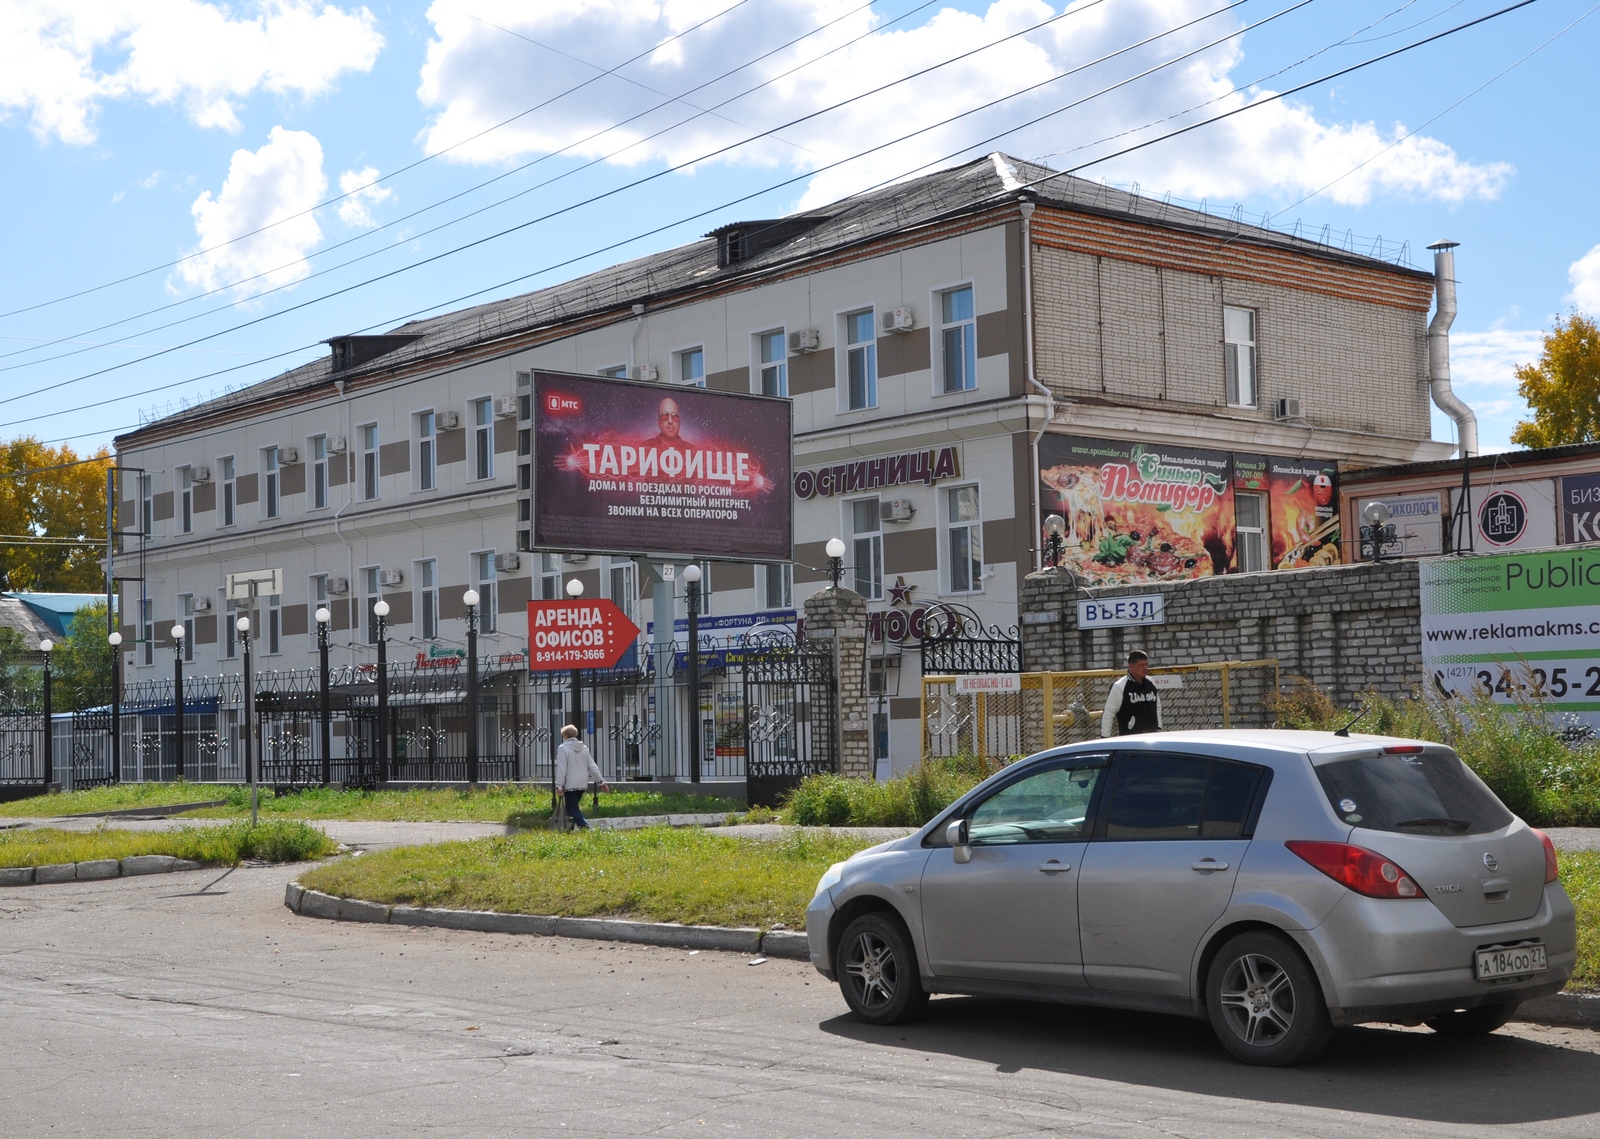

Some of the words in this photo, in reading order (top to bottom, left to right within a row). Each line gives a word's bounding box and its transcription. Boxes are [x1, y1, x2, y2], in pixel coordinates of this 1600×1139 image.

[562, 400, 578, 409] МТС
[1072, 446, 1129, 458] www.spomidor.ru
[583, 444, 750, 485] ТАРИФИЩЕ
[1139, 453, 1201, 485] Синьор
[1161, 455, 1206, 466] Итальянская
[1207, 460, 1227, 469] пицца!
[1235, 461, 1257, 469] Ленина
[1258, 462, 1266, 470] 39
[794, 447, 958, 500] ОСТИНИЦА
[1241, 470, 1264, 479] 201-001
[1272, 465, 1302, 475] Японская
[1303, 467, 1320, 477] кухня
[589, 480, 617, 492] ДОМА
[619, 482, 625, 491] И
[628, 482, 633, 491] В
[636, 482, 681, 495] ПОЕЗДКАХ
[684, 484, 696, 494] ПО
[698, 485, 732, 496] РОССИИ
[1101, 464, 1214, 513] Помидор
[640, 495, 706, 507] БЕЗЛИМИТНЫЙ
[709, 498, 751, 510] ИНТЕРНЕТ,
[1387, 501, 1439, 515] СИХОЛОГИ
[608, 505, 644, 517] ЗВОНКИ
[646, 507, 659, 517] НА
[661, 508, 682, 518] ВСЕХ
[684, 508, 738, 520] ОПЕРАТОРОВ
[664, 567, 673, 576] 27
[1459, 564, 1501, 573] Рекламно
[1425, 575, 1501, 587] информационное
[1462, 586, 1501, 594] агентство
[535, 607, 603, 628] АРЕНДА
[1086, 601, 1155, 621] ВЪЕЗД
[715, 617, 752, 627] «ФОРТУНА
[535, 629, 604, 648] ОФИСОВ
[1426, 621, 1600, 642] www.reklamakms.c
[536, 649, 605, 662] 8-914-179-3666
[1446, 666, 1477, 680] (4217)
[1435, 884, 1462, 894] TIIDA
[1531, 948, 1541, 962] 27
